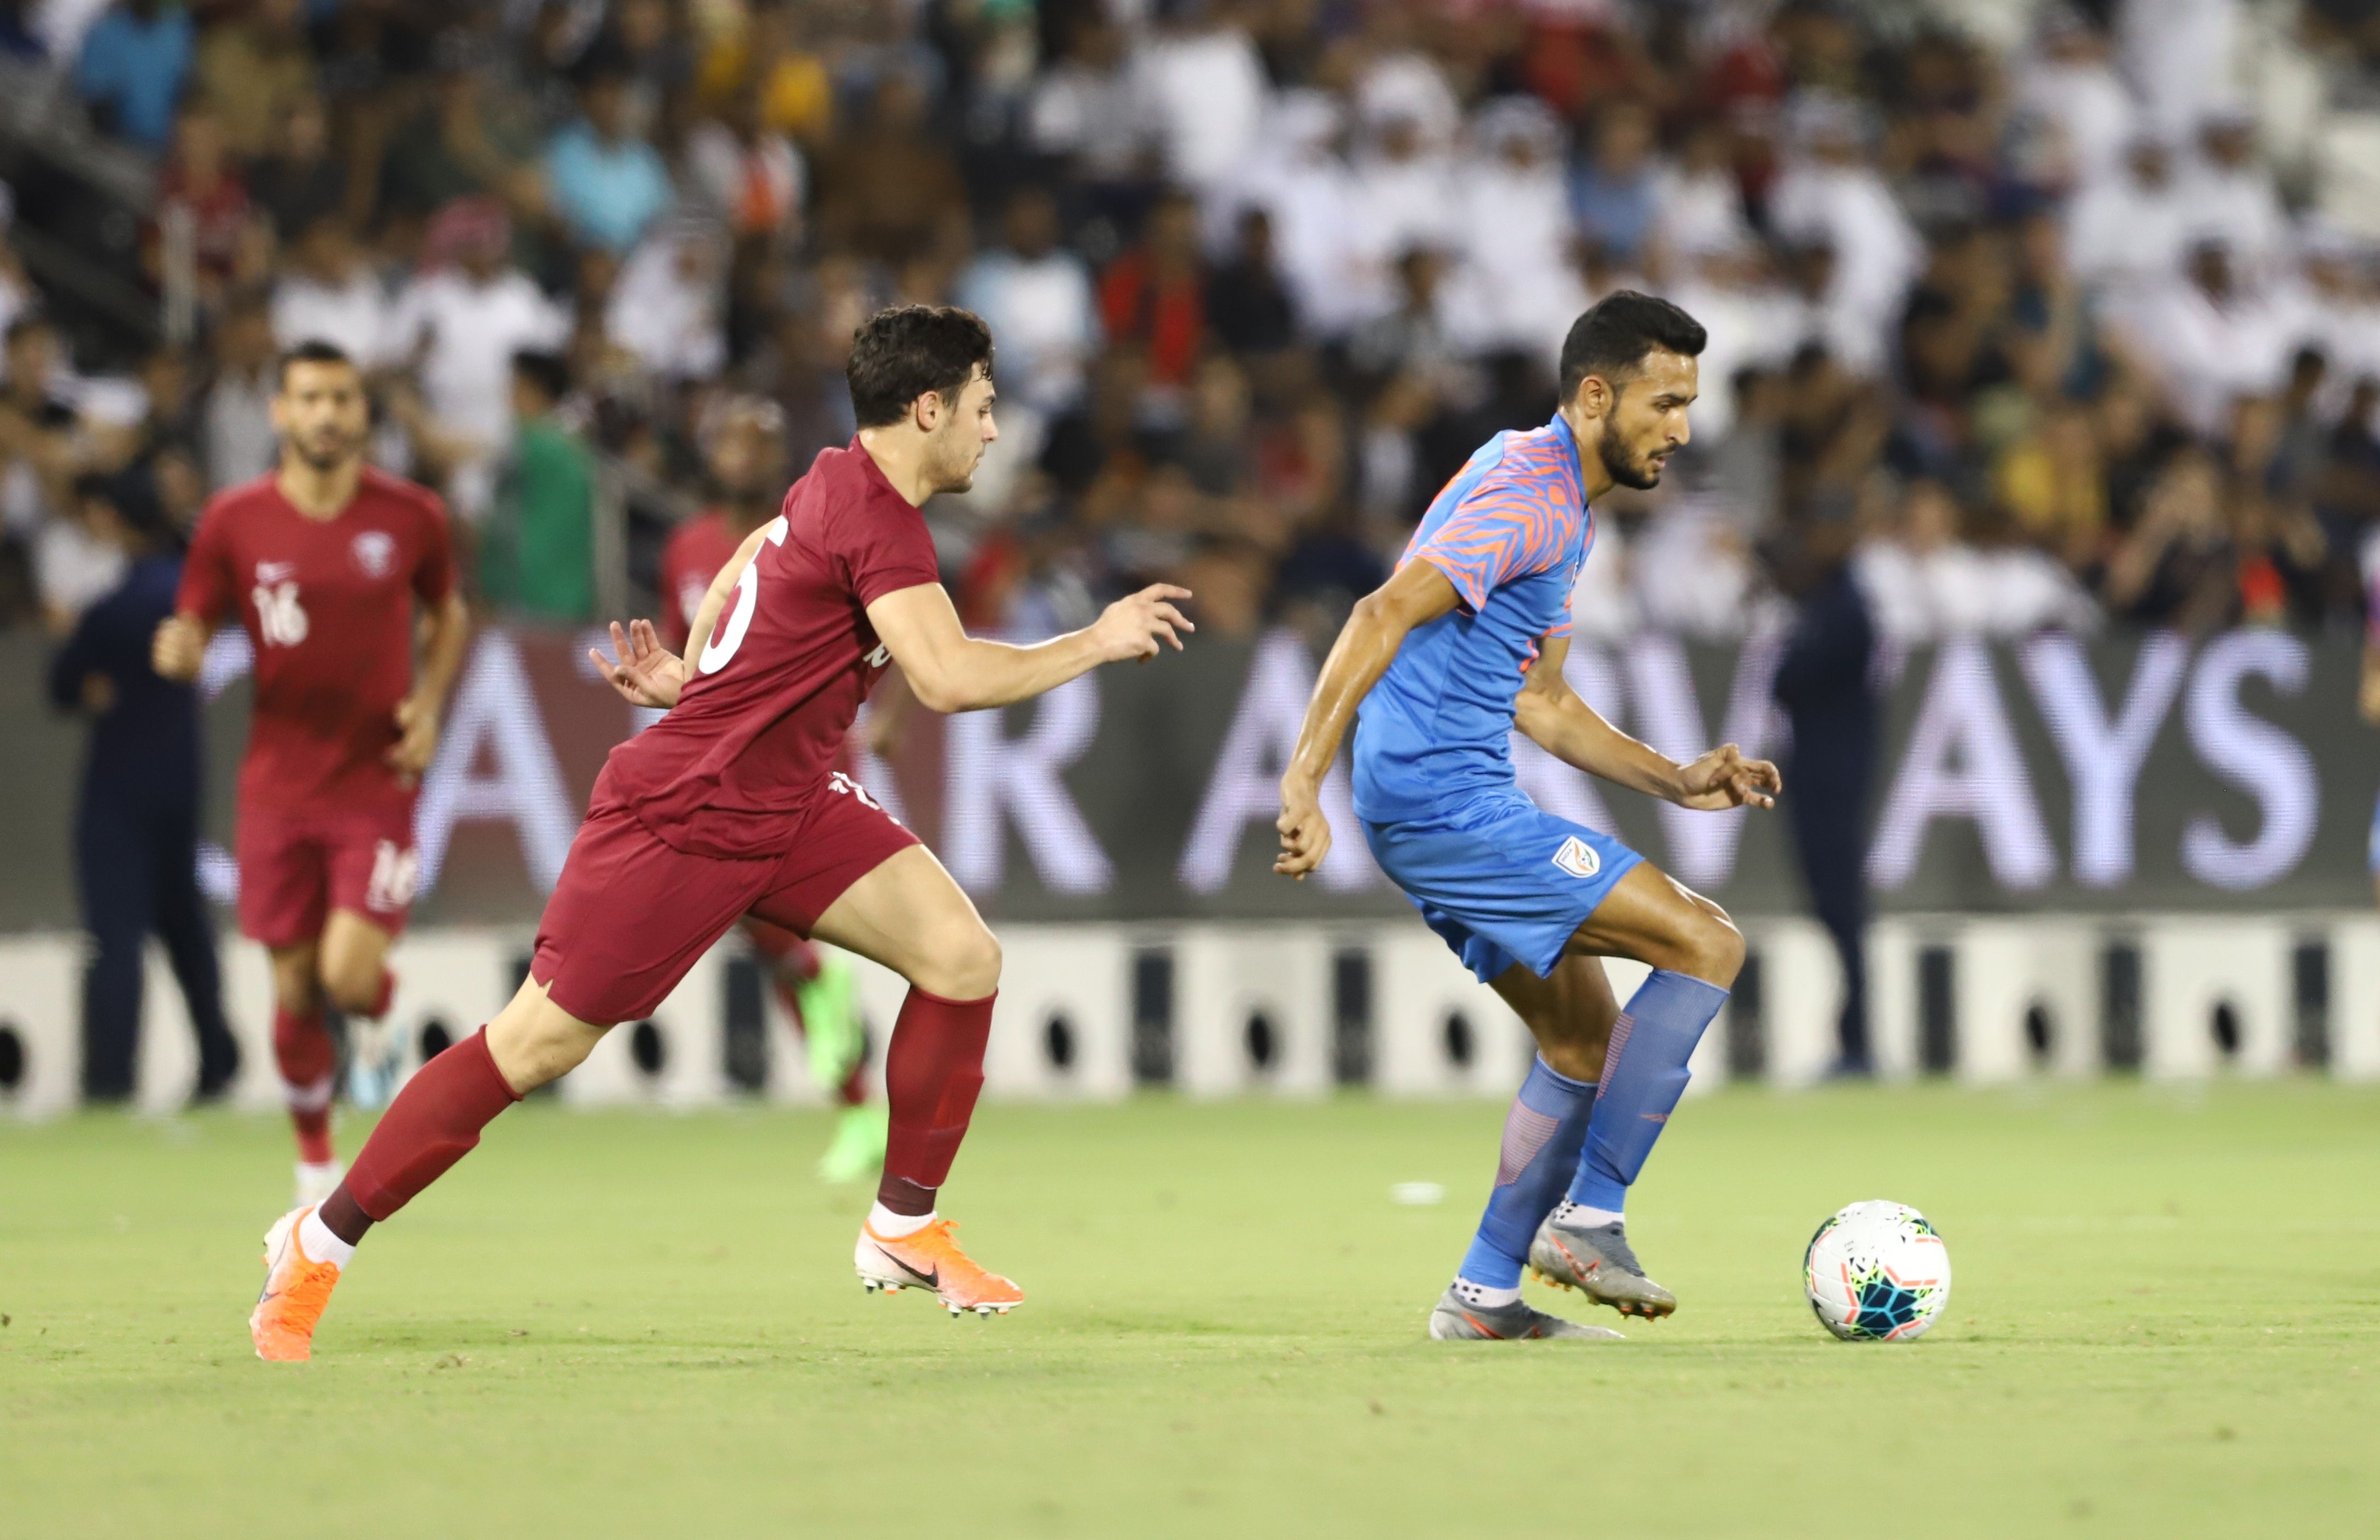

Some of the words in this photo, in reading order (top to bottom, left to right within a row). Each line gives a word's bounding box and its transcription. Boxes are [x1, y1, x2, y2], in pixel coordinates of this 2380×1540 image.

[252, 583, 308, 646] 16
[1176, 628, 2320, 892] AWAYS
[365, 839, 418, 912] 16
